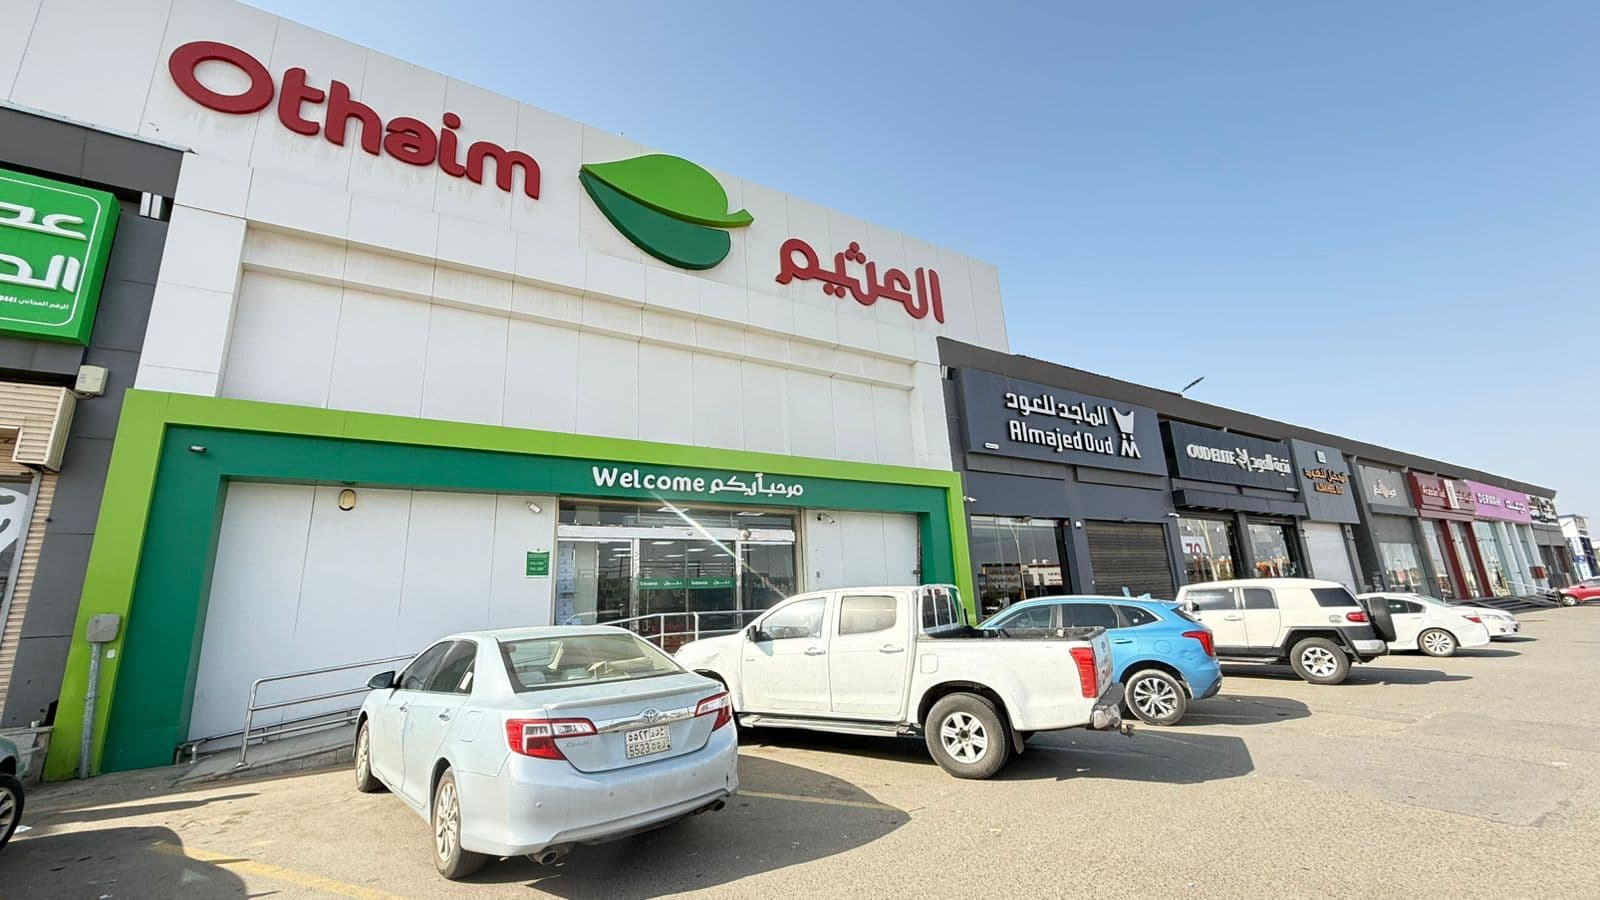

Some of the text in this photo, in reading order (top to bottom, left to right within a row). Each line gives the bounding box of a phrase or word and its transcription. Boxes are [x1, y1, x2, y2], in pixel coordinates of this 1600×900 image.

[168, 41, 541, 200] Othaim
[775, 238, 944, 324] العثيم
[1006, 392, 1109, 427] الماجد للعود
[1009, 420, 1113, 455] Almajed Oud
[1186, 444, 1211, 460] OUD
[592, 466, 705, 492] Welcome
[709, 475, 757, 496] بكم
[629, 743, 650, 756] 5523
